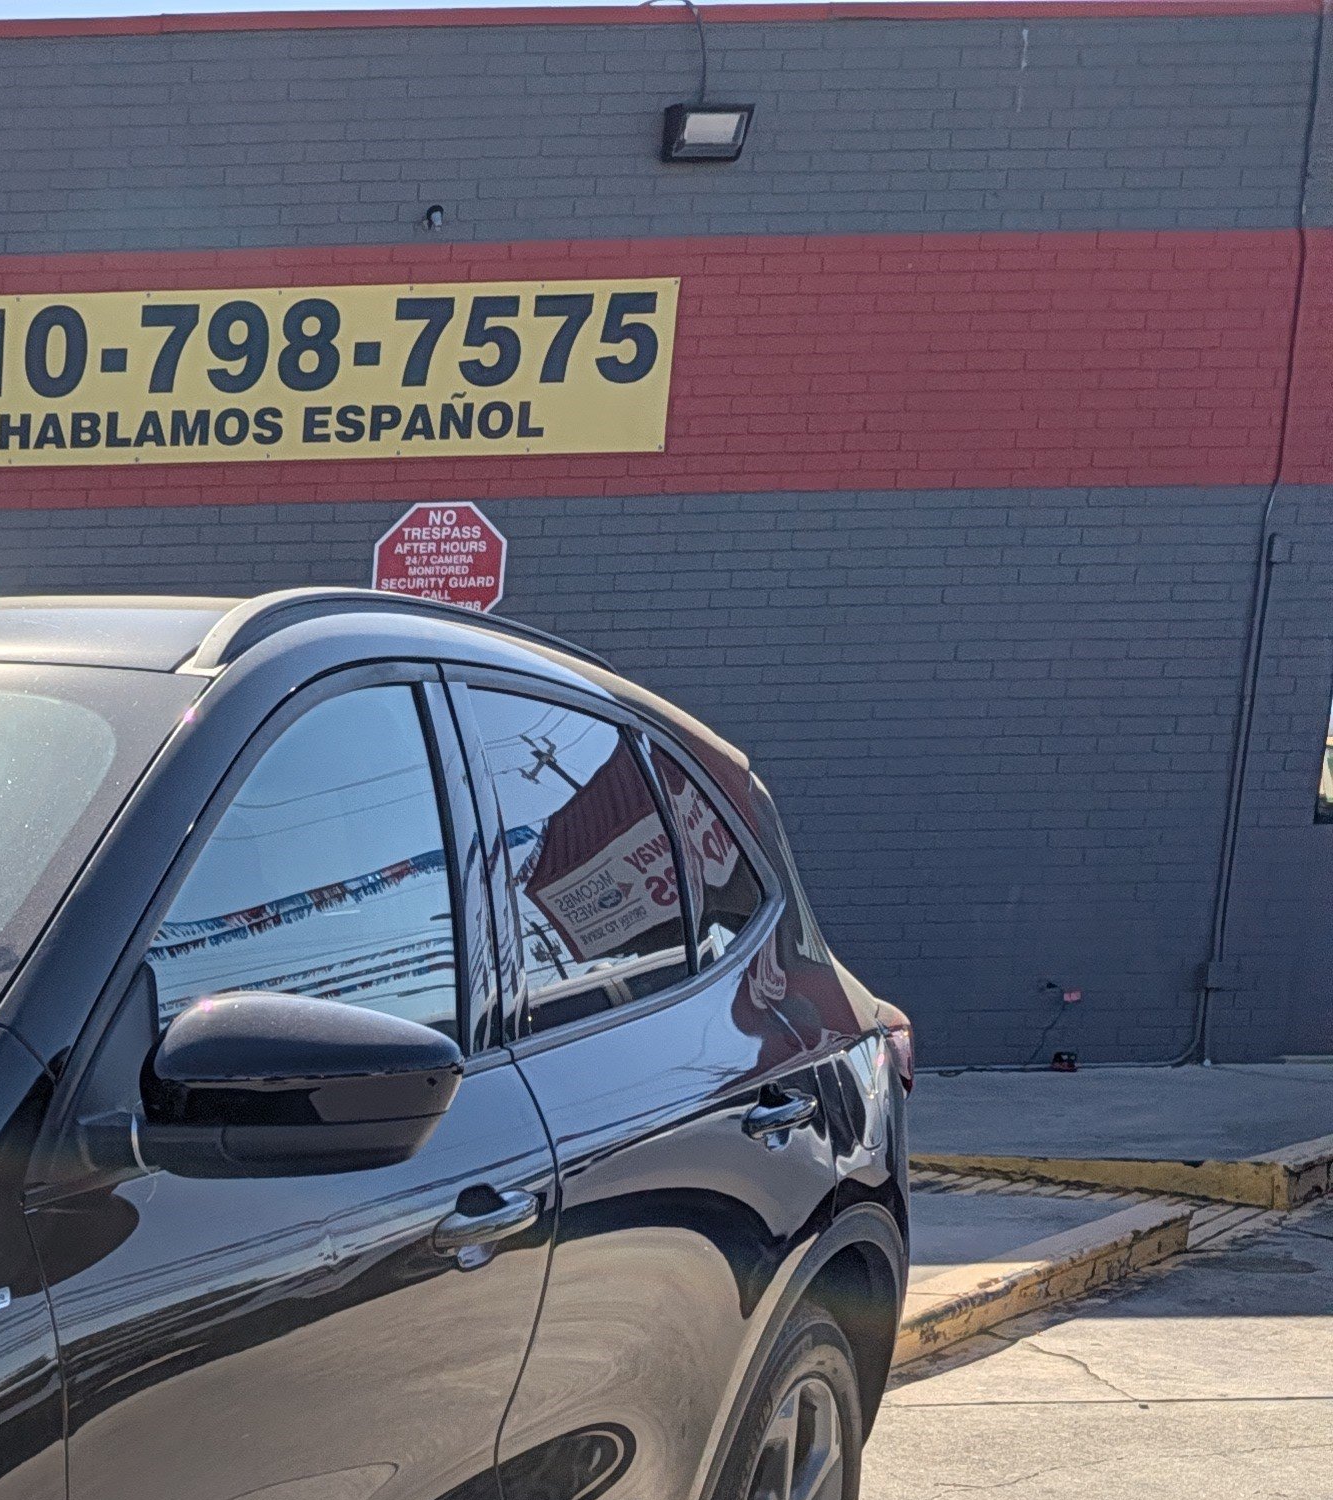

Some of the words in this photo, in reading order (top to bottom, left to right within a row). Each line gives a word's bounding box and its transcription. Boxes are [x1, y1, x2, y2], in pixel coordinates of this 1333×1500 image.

[302, 391, 545, 443] ESPAÑOL
[428, 509, 457, 526] NO
[402, 525, 481, 541] TRESPASS
[394, 542, 437, 554] AFTER
[440, 540, 487, 553] HOURS
[405, 555, 427, 566] 24/7
[429, 554, 474, 565] CAMERA
[408, 565, 469, 576] MONITORED
[381, 577, 446, 590] SECURITY
[448, 576, 495, 589] GUARD
[421, 589, 451, 600] CALL
